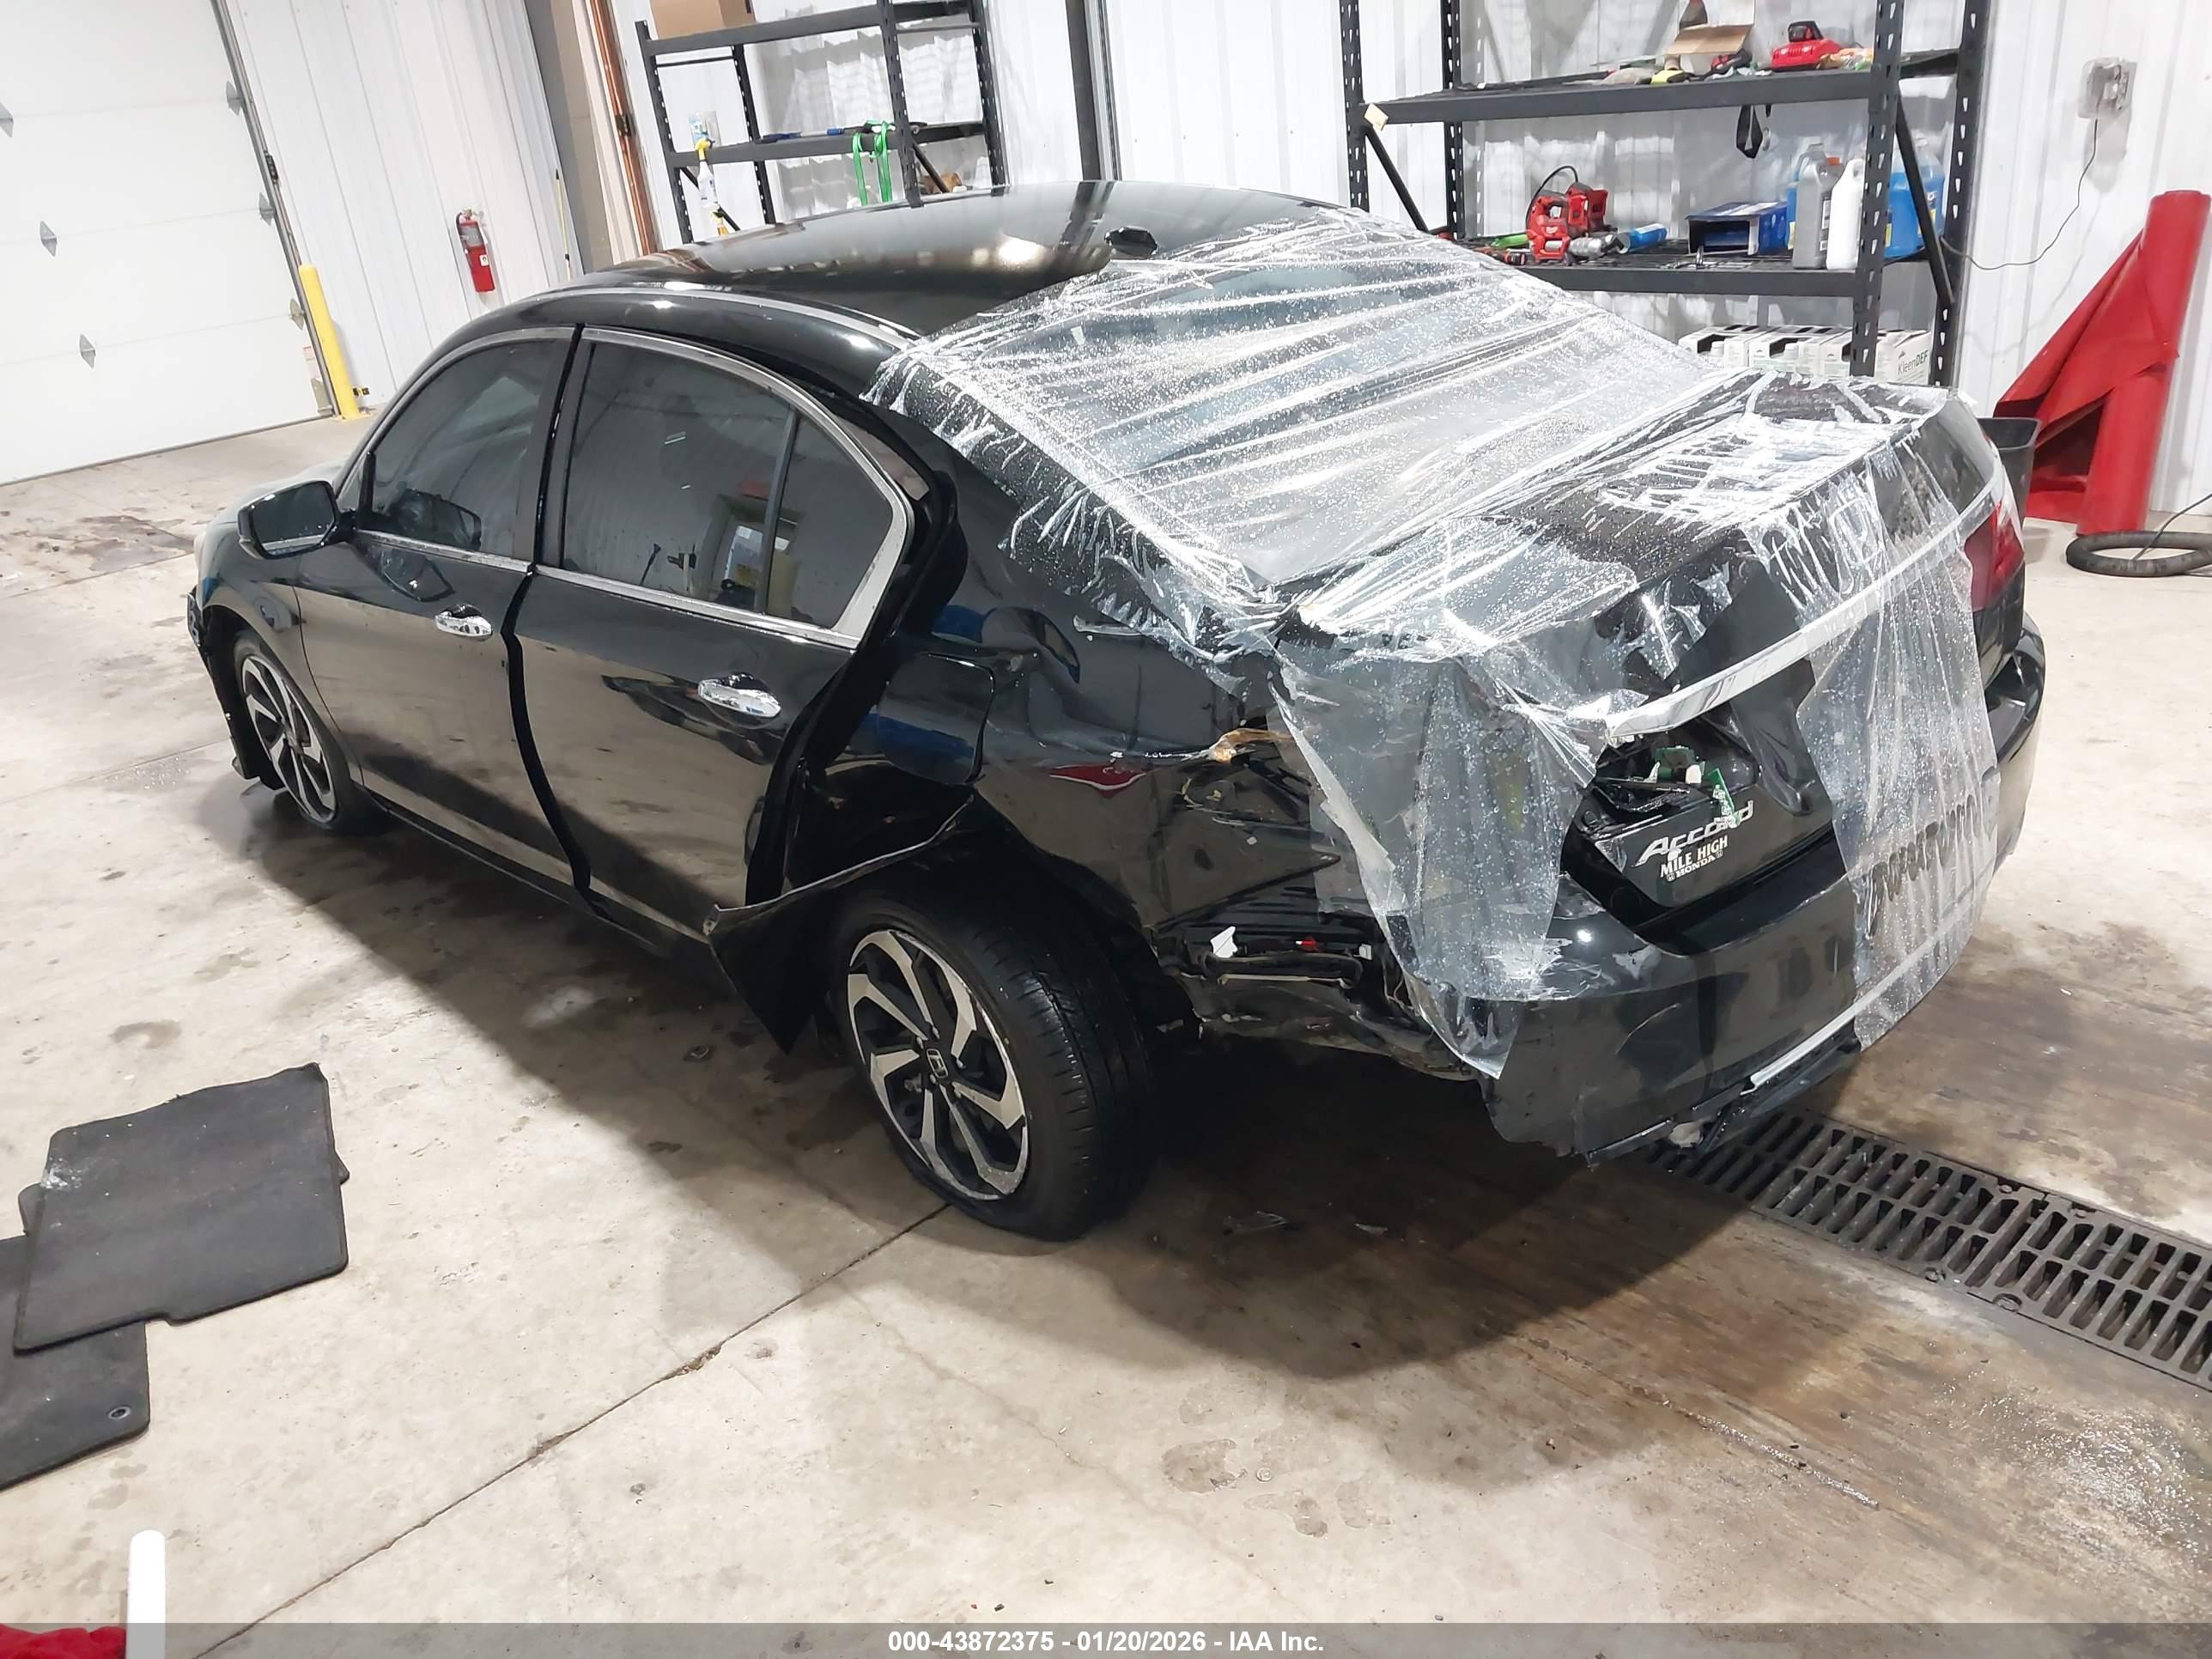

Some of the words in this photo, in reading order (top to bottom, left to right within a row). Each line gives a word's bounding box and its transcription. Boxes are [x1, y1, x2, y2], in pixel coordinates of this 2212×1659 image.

[1897, 349, 1929, 376] KleenDEF
[1660, 851, 1693, 878] MILE
[1698, 835, 1729, 860] HIGH
[1674, 855, 1716, 878] HONDA
